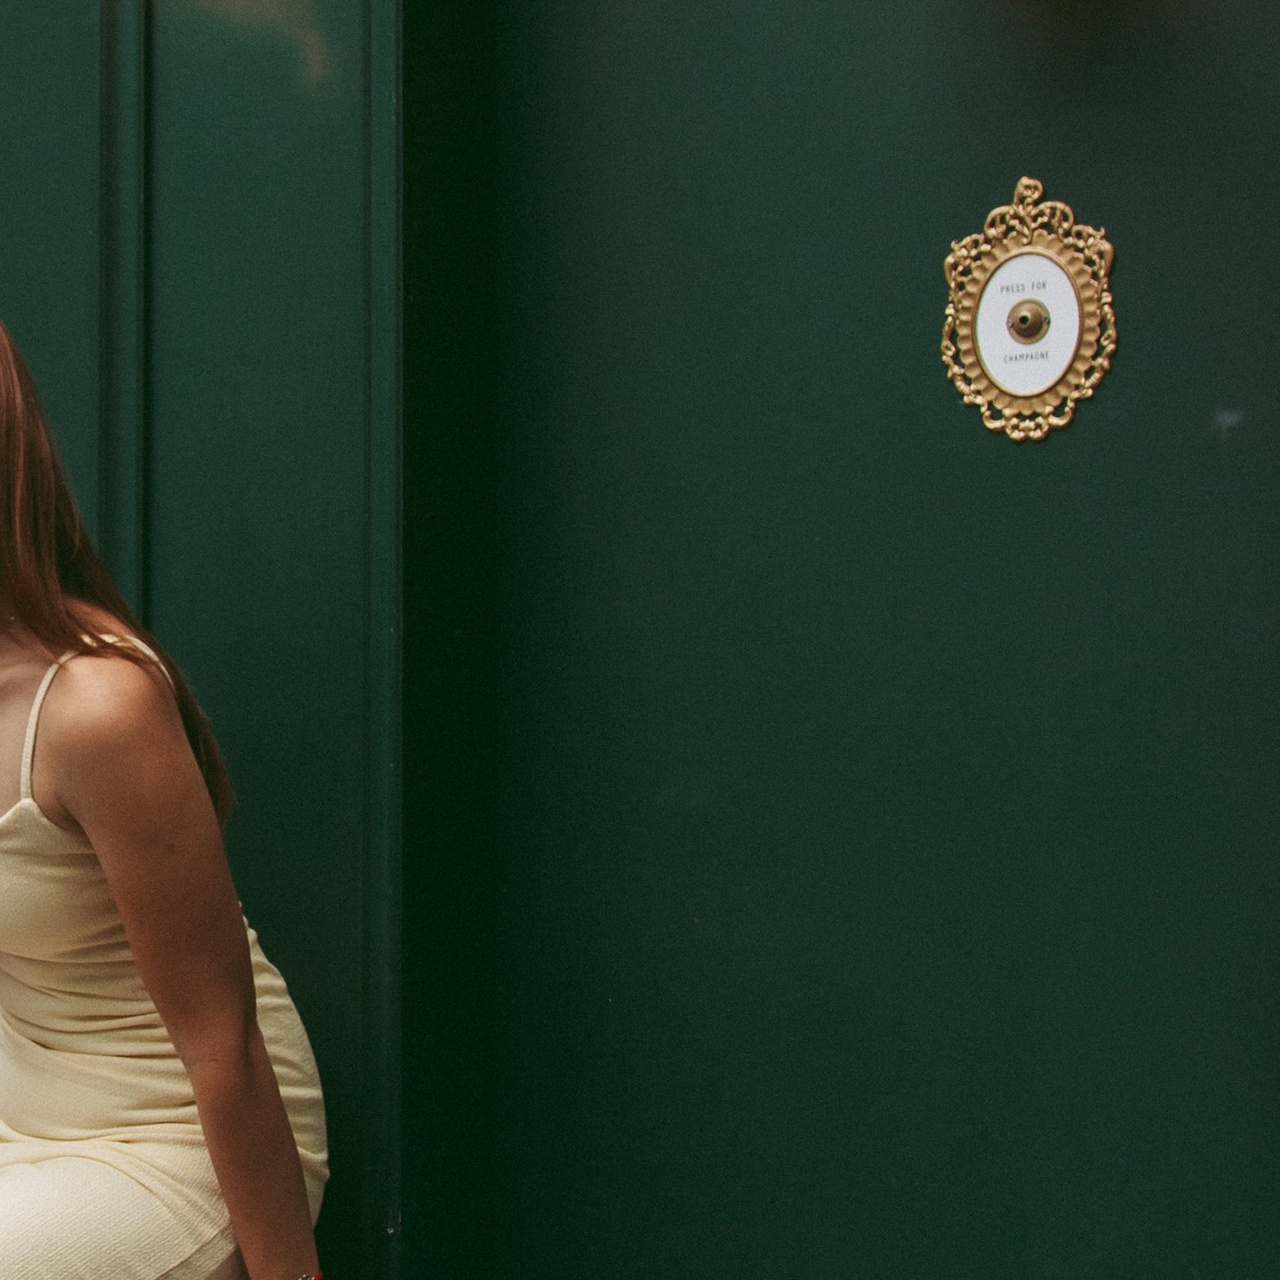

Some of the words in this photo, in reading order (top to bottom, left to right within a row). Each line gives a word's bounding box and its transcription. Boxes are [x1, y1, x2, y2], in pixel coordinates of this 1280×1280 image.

[1000, 282, 1026, 293] PRESS
[1031, 280, 1047, 291] FOR
[1003, 351, 1049, 364] CHAMPAGNE
